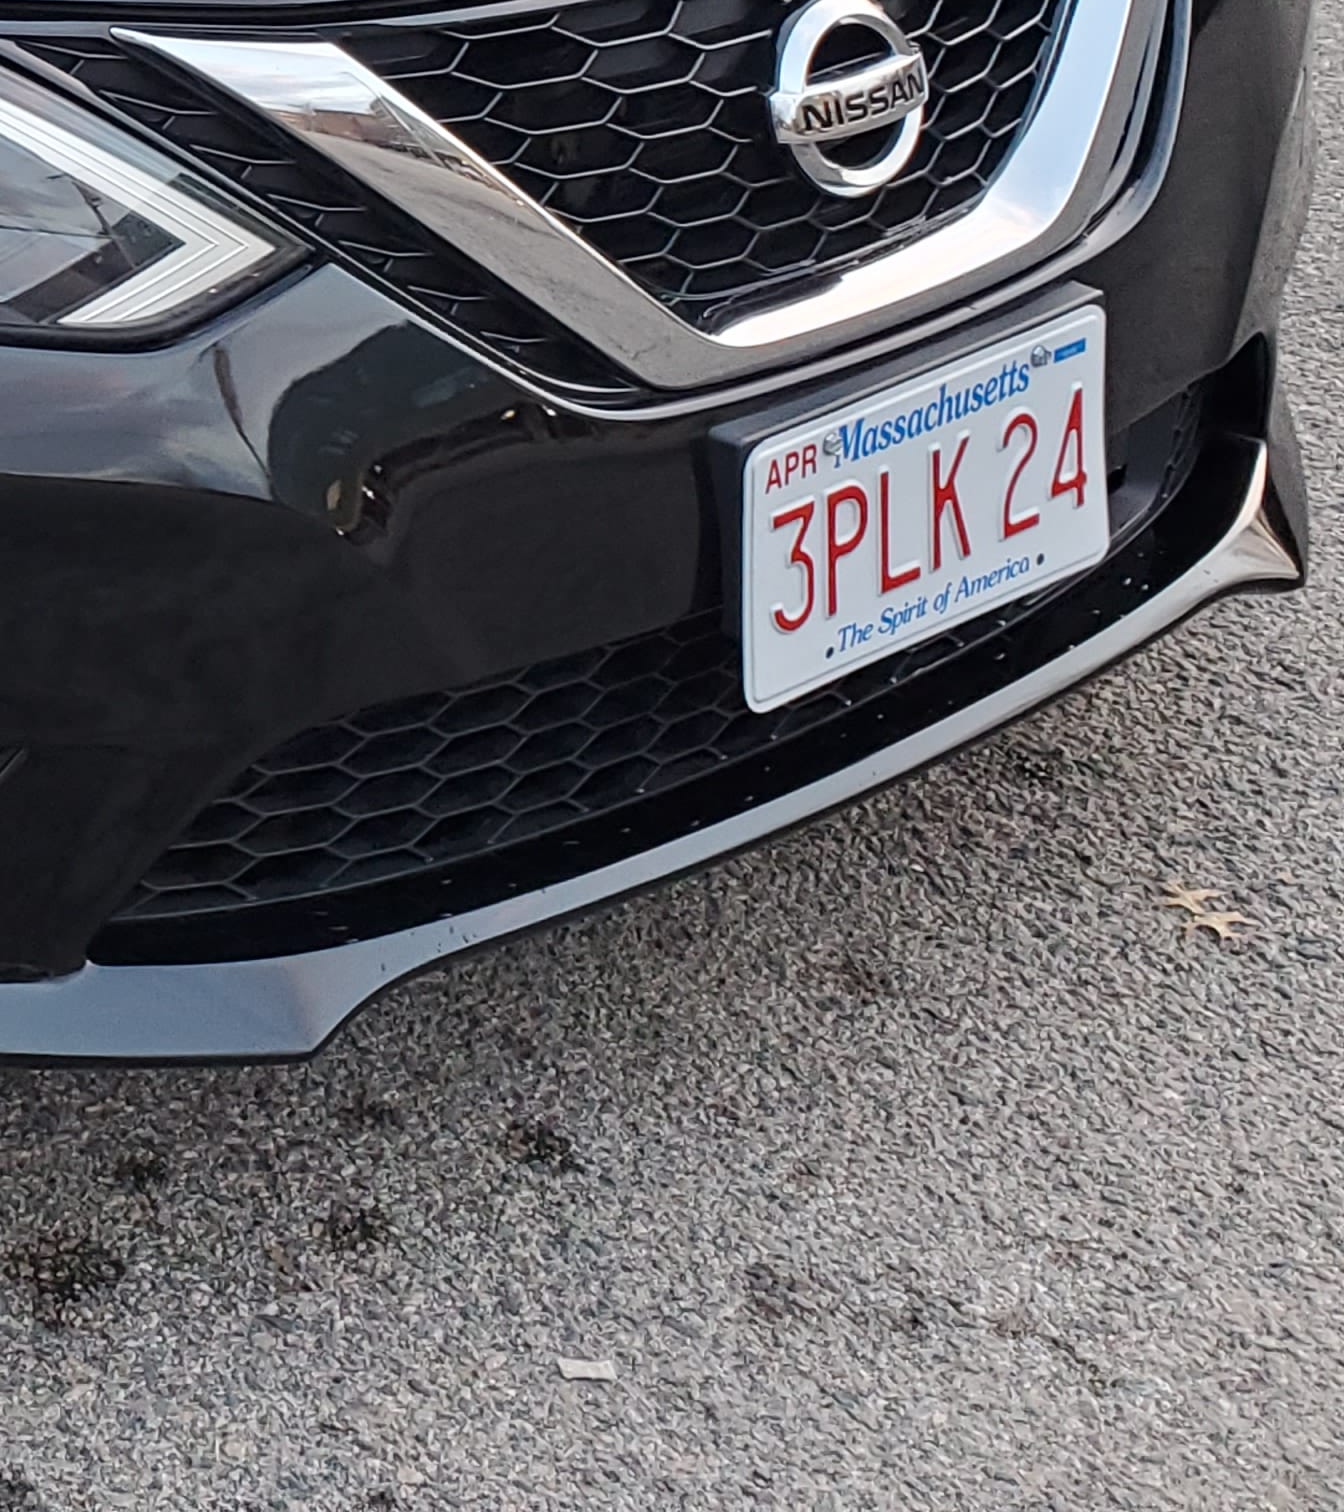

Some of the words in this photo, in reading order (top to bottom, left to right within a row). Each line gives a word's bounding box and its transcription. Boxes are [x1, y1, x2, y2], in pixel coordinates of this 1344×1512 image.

[802, 64, 925, 132] NISSAN
[833, 360, 1031, 469] Massachusetts
[765, 443, 818, 495] APR
[771, 436, 972, 633] 3PLK
[1002, 388, 1088, 540] 24
[837, 622, 874, 653] The
[877, 597, 928, 635] Spirit
[933, 581, 953, 615] of
[954, 556, 1030, 603] America
